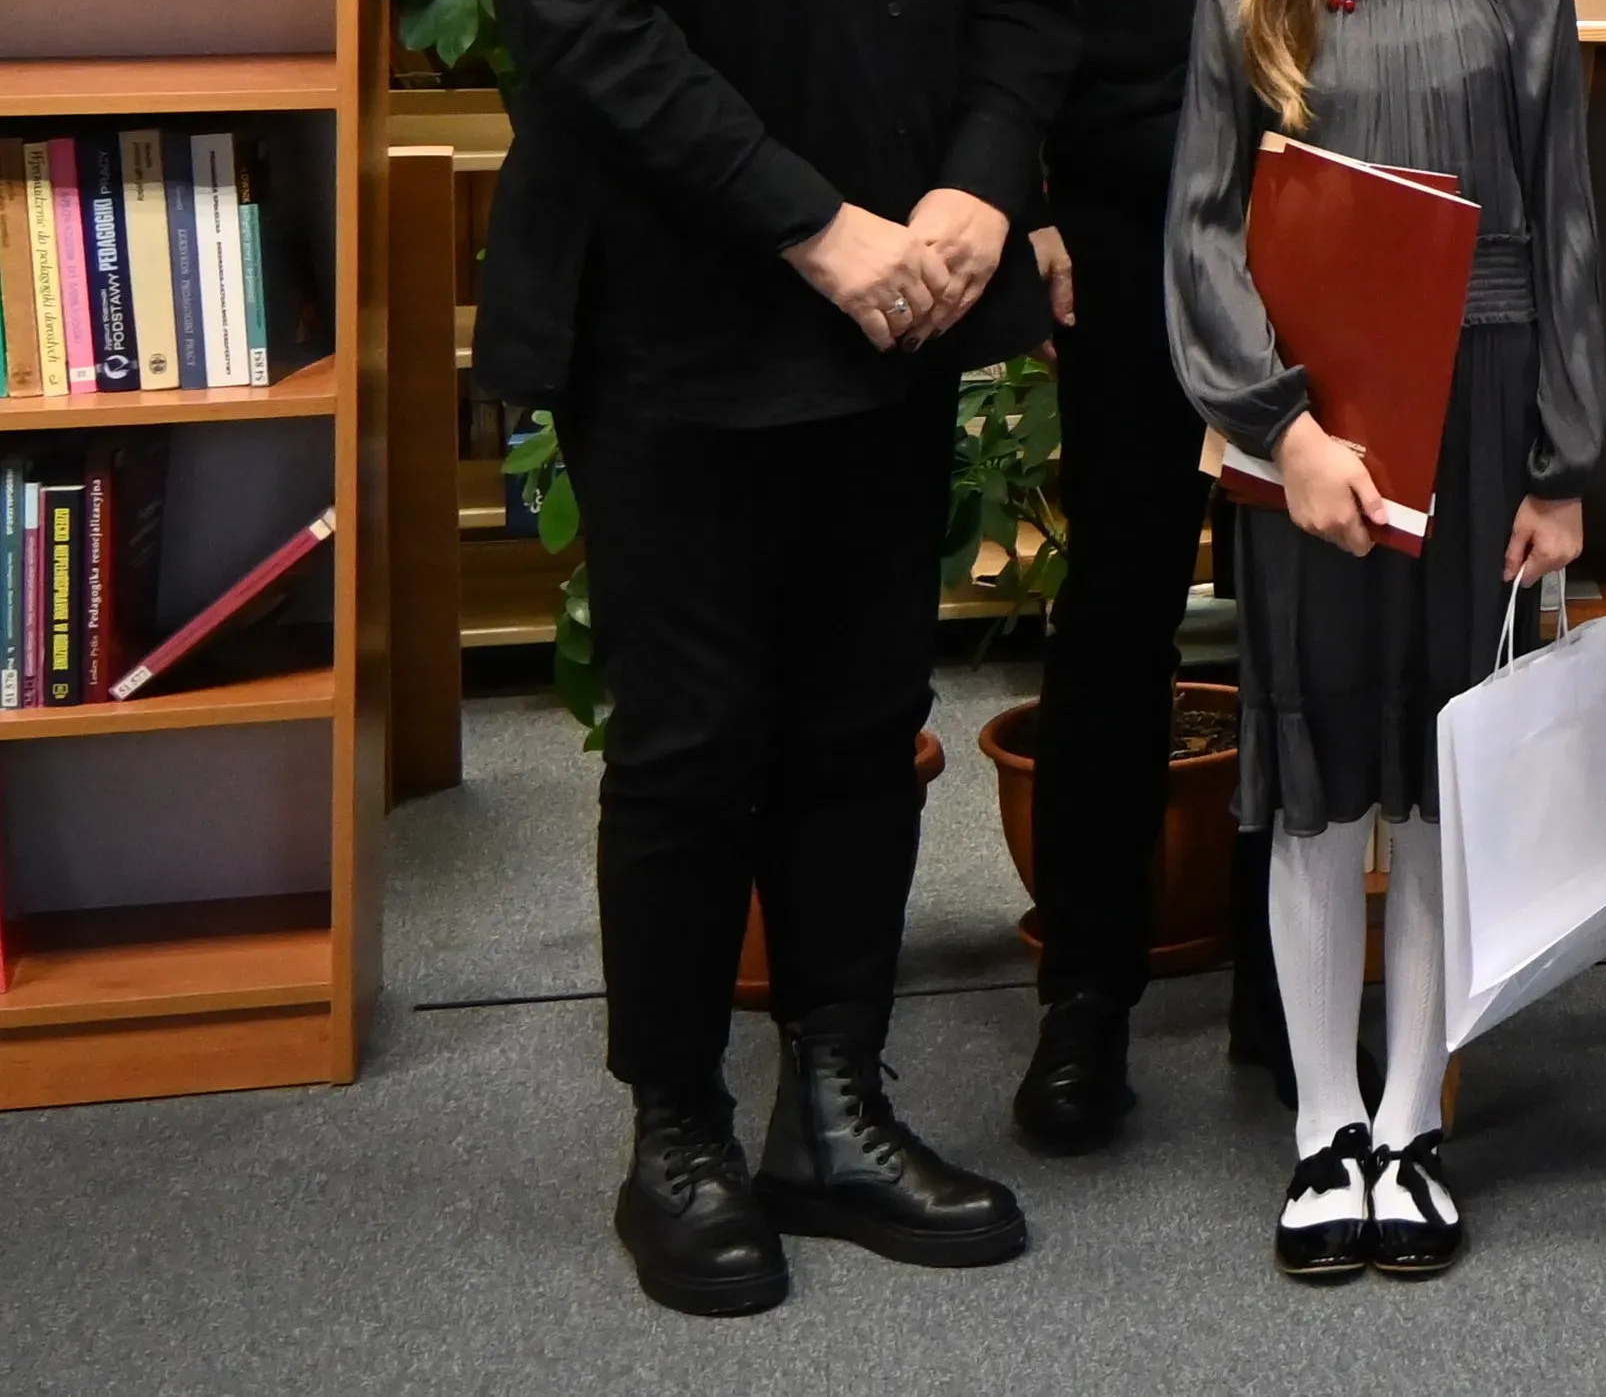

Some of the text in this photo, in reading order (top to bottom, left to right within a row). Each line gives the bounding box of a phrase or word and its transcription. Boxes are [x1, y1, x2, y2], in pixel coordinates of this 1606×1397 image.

[37, 231, 50, 245] do
[93, 149, 125, 351] PODSTAWY PEDAGOGIKI PRACY
[36, 249, 56, 307] pedagogiki
[44, 313, 60, 363] dorosłych
[184, 338, 196, 367] PRACY
[88, 479, 104, 628] Pedagogika resocjalizacyjna
